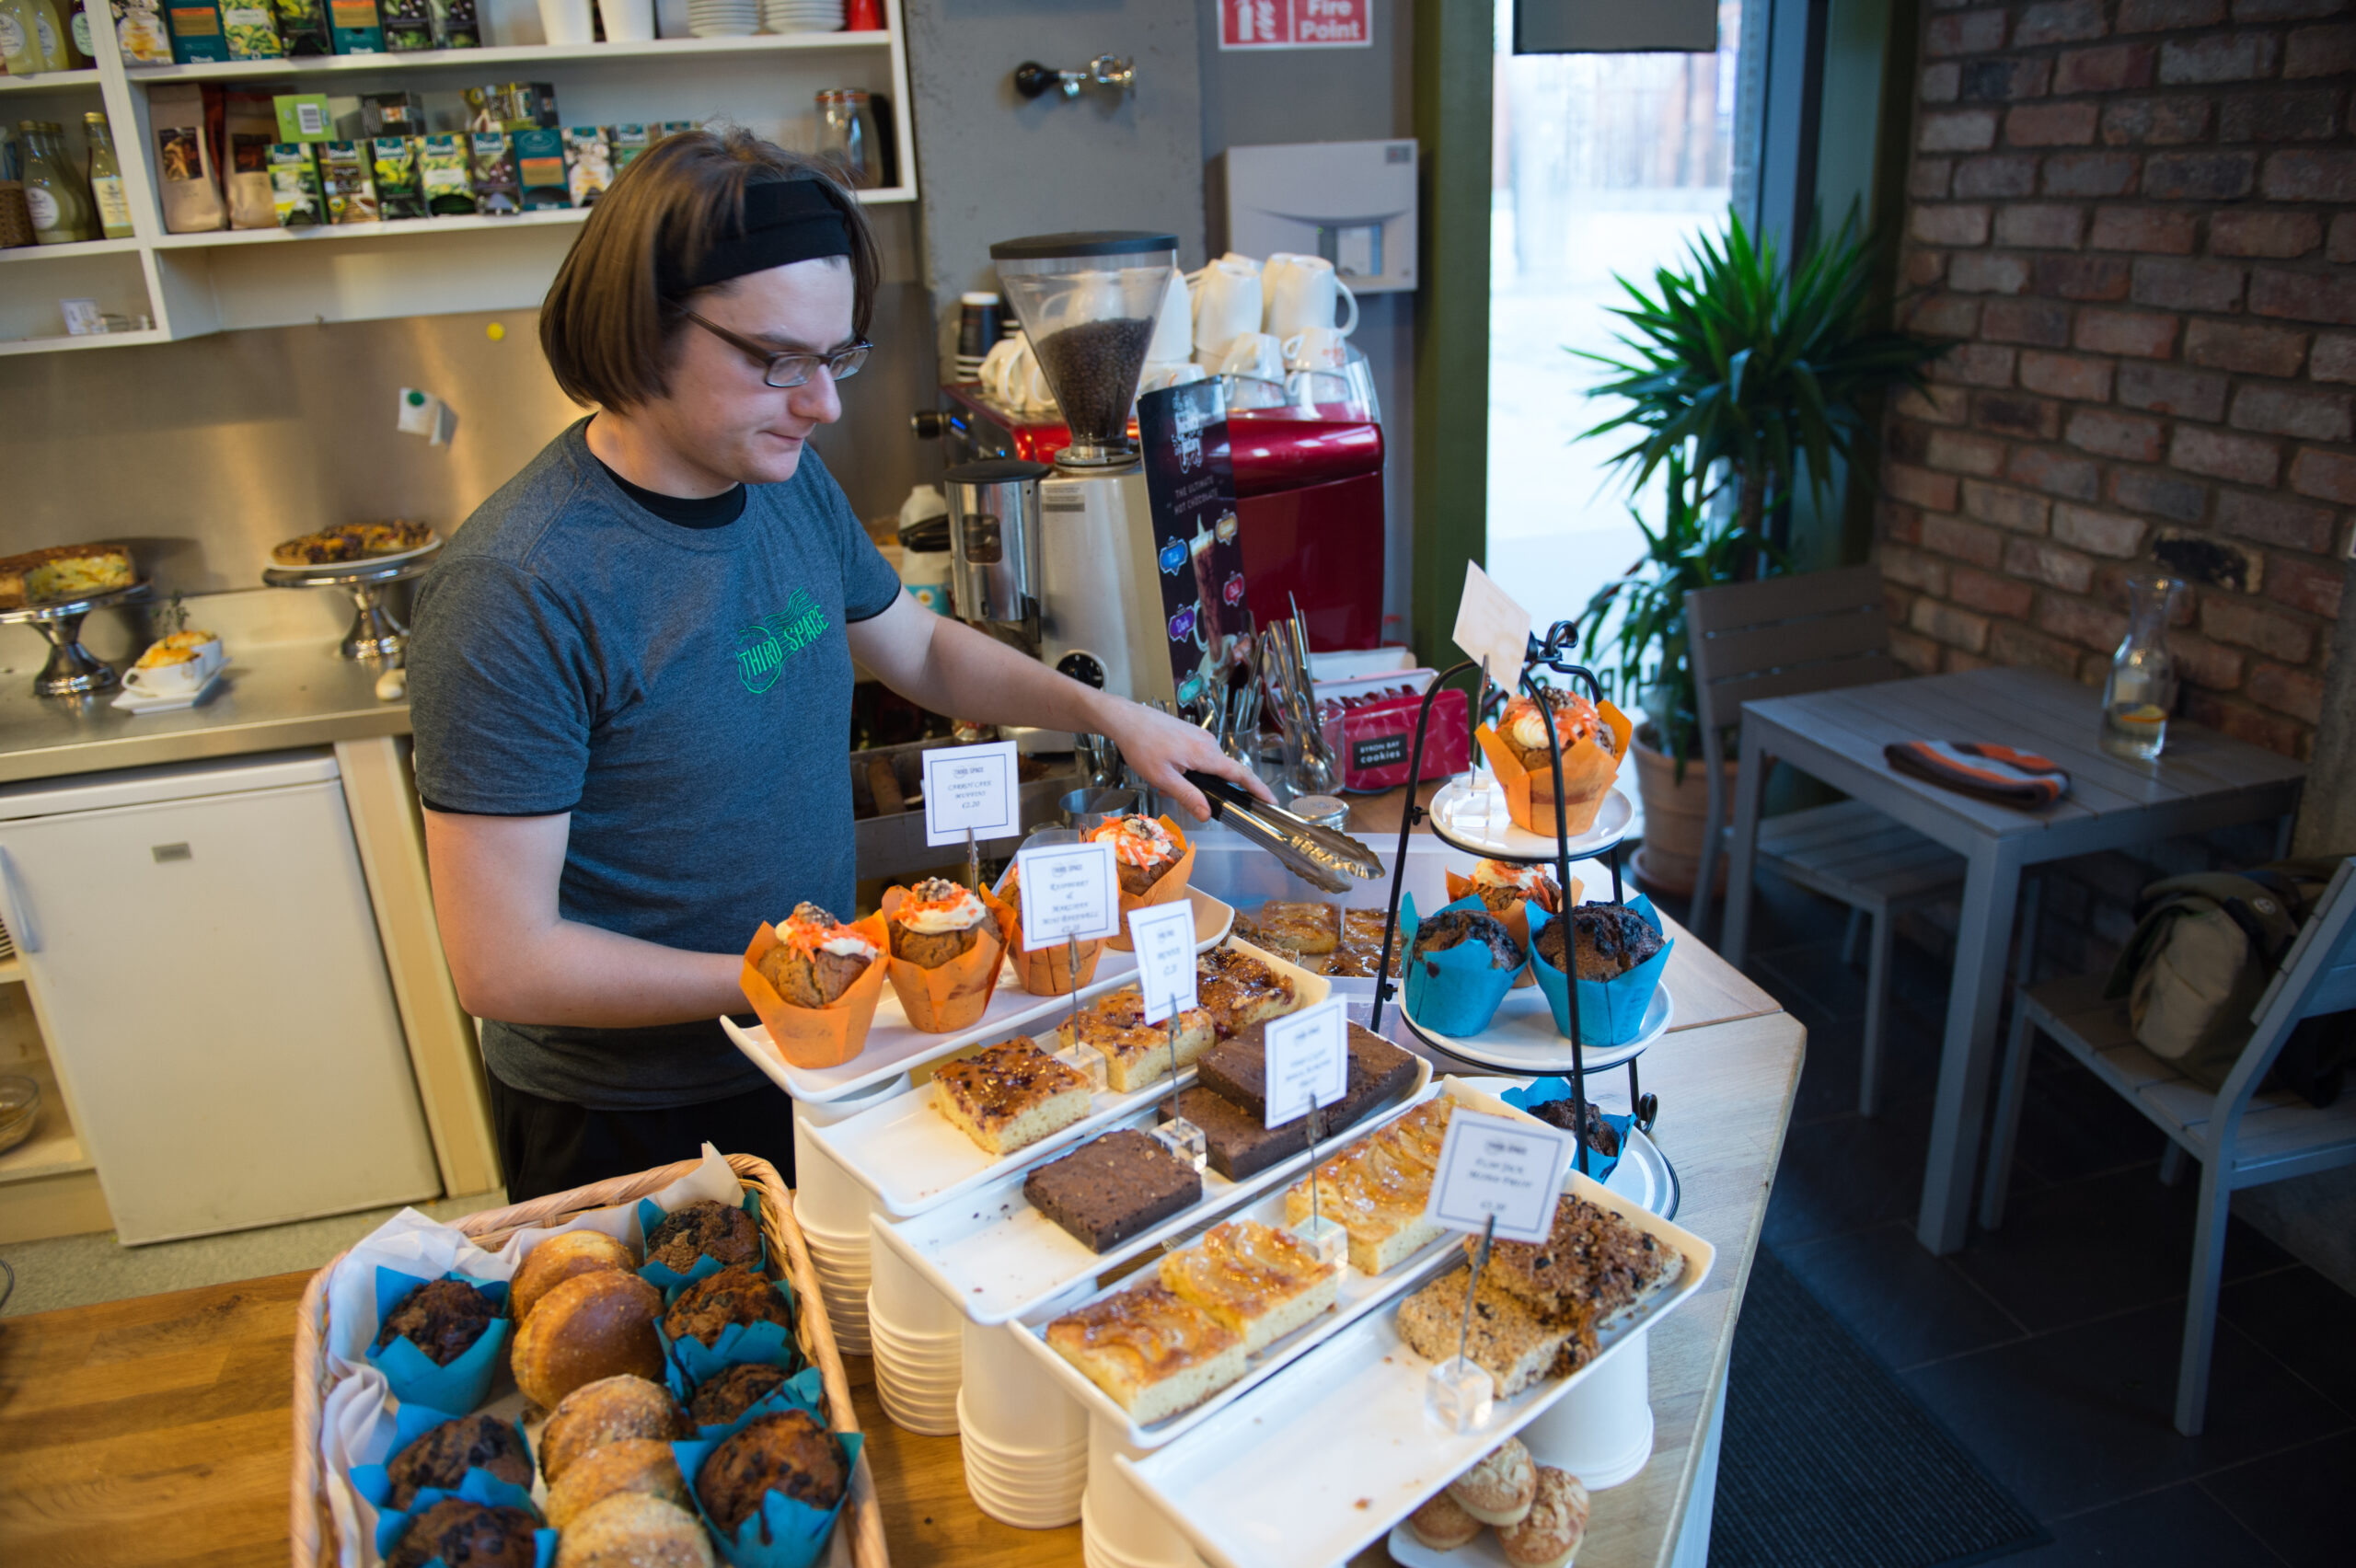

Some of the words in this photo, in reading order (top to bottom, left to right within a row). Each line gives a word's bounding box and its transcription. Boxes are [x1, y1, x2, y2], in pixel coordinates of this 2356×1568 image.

[1307, 0, 1353, 17] Fire
[1300, 19, 1360, 40] Point
[739, 637, 783, 680] THIRD
[784, 605, 829, 651] SPACE
[1360, 744, 1385, 755] BYRON
[1386, 740, 1401, 750] BAY
[1360, 750, 1401, 765] cookies
